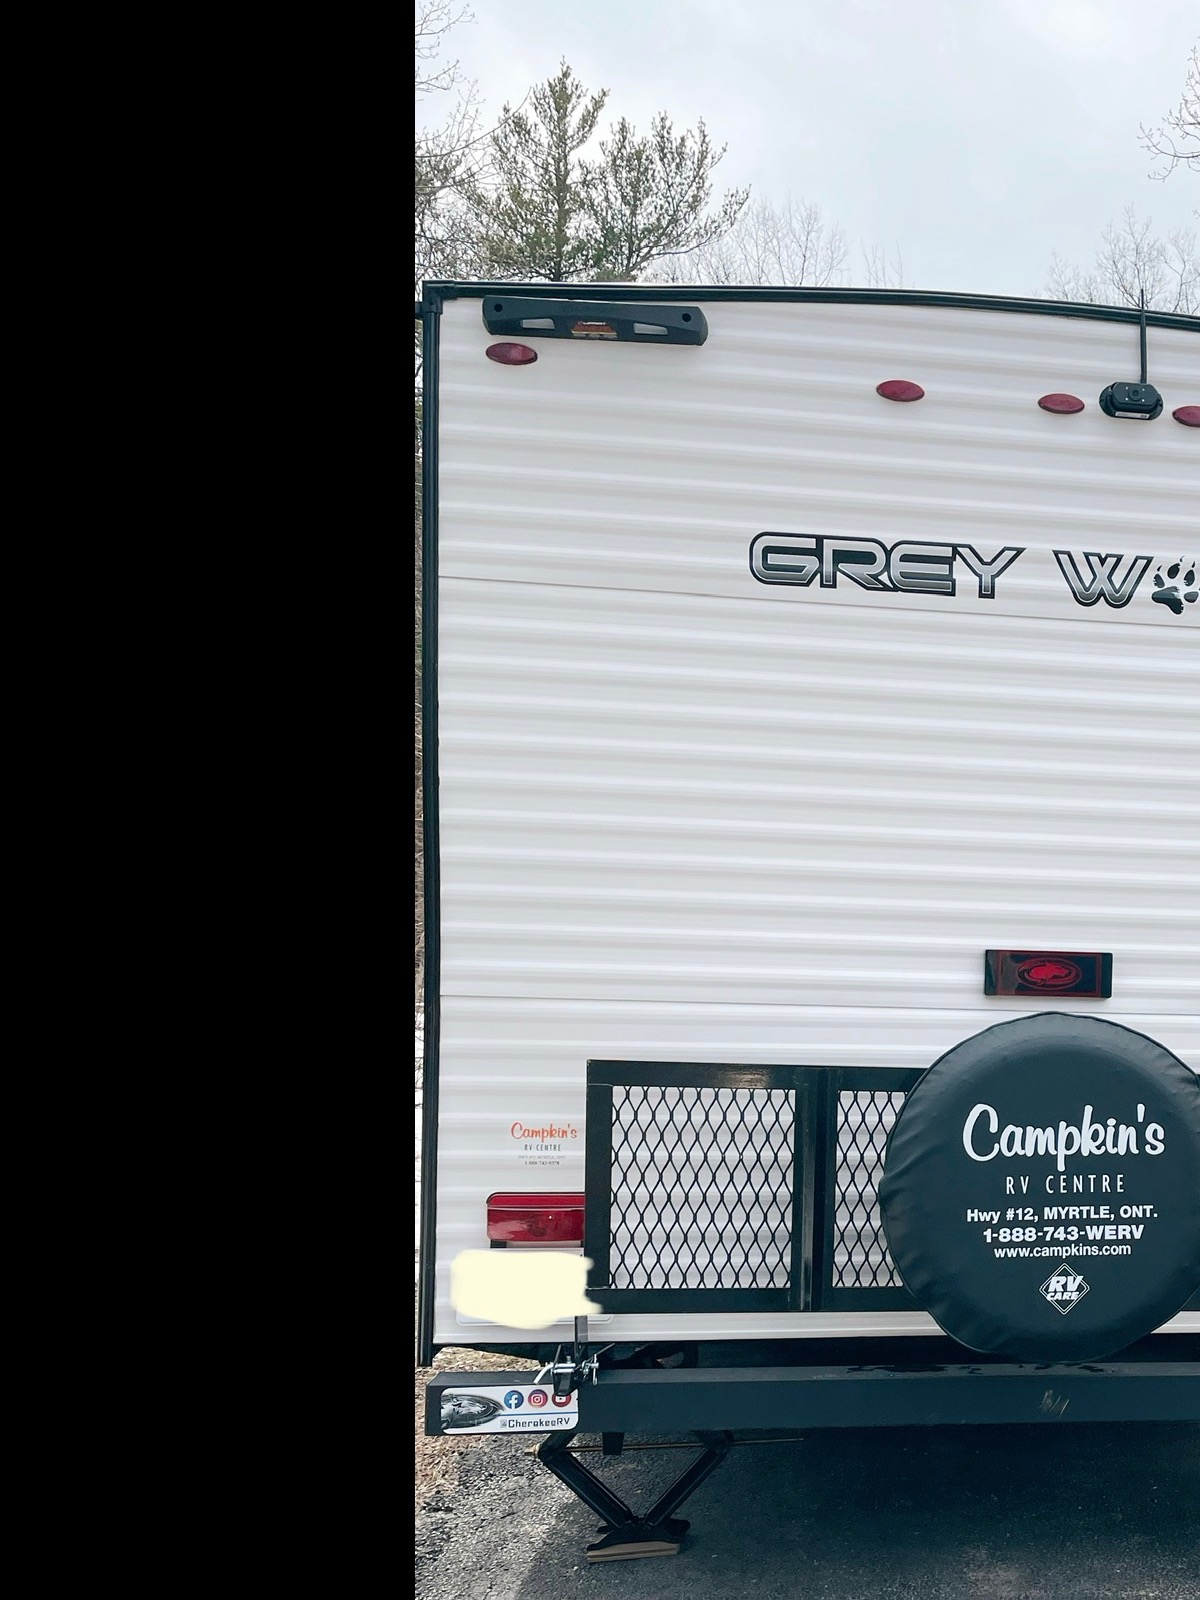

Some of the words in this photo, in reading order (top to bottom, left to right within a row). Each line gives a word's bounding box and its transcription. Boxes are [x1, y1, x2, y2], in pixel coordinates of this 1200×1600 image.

[749, 531, 1027, 600] GREY
[510, 1122, 578, 1143] Campkin's
[963, 1103, 1166, 1172] Campkin's
[536, 1144, 561, 1152] CENTRE
[1005, 1175, 1030, 1195] RV
[1045, 1174, 1126, 1195] CENTRE
[966, 1208, 1001, 1224] Hwy
[1005, 1206, 1039, 1222] #12,
[1043, 1206, 1115, 1221] MYRTLE,
[1119, 1205, 1158, 1218] ONT.
[983, 1224, 1145, 1243] 1-888-743-WERV
[994, 1243, 1131, 1259] www.campkins.com
[1047, 1275, 1084, 1292] RV
[1046, 1291, 1080, 1301] CARE
